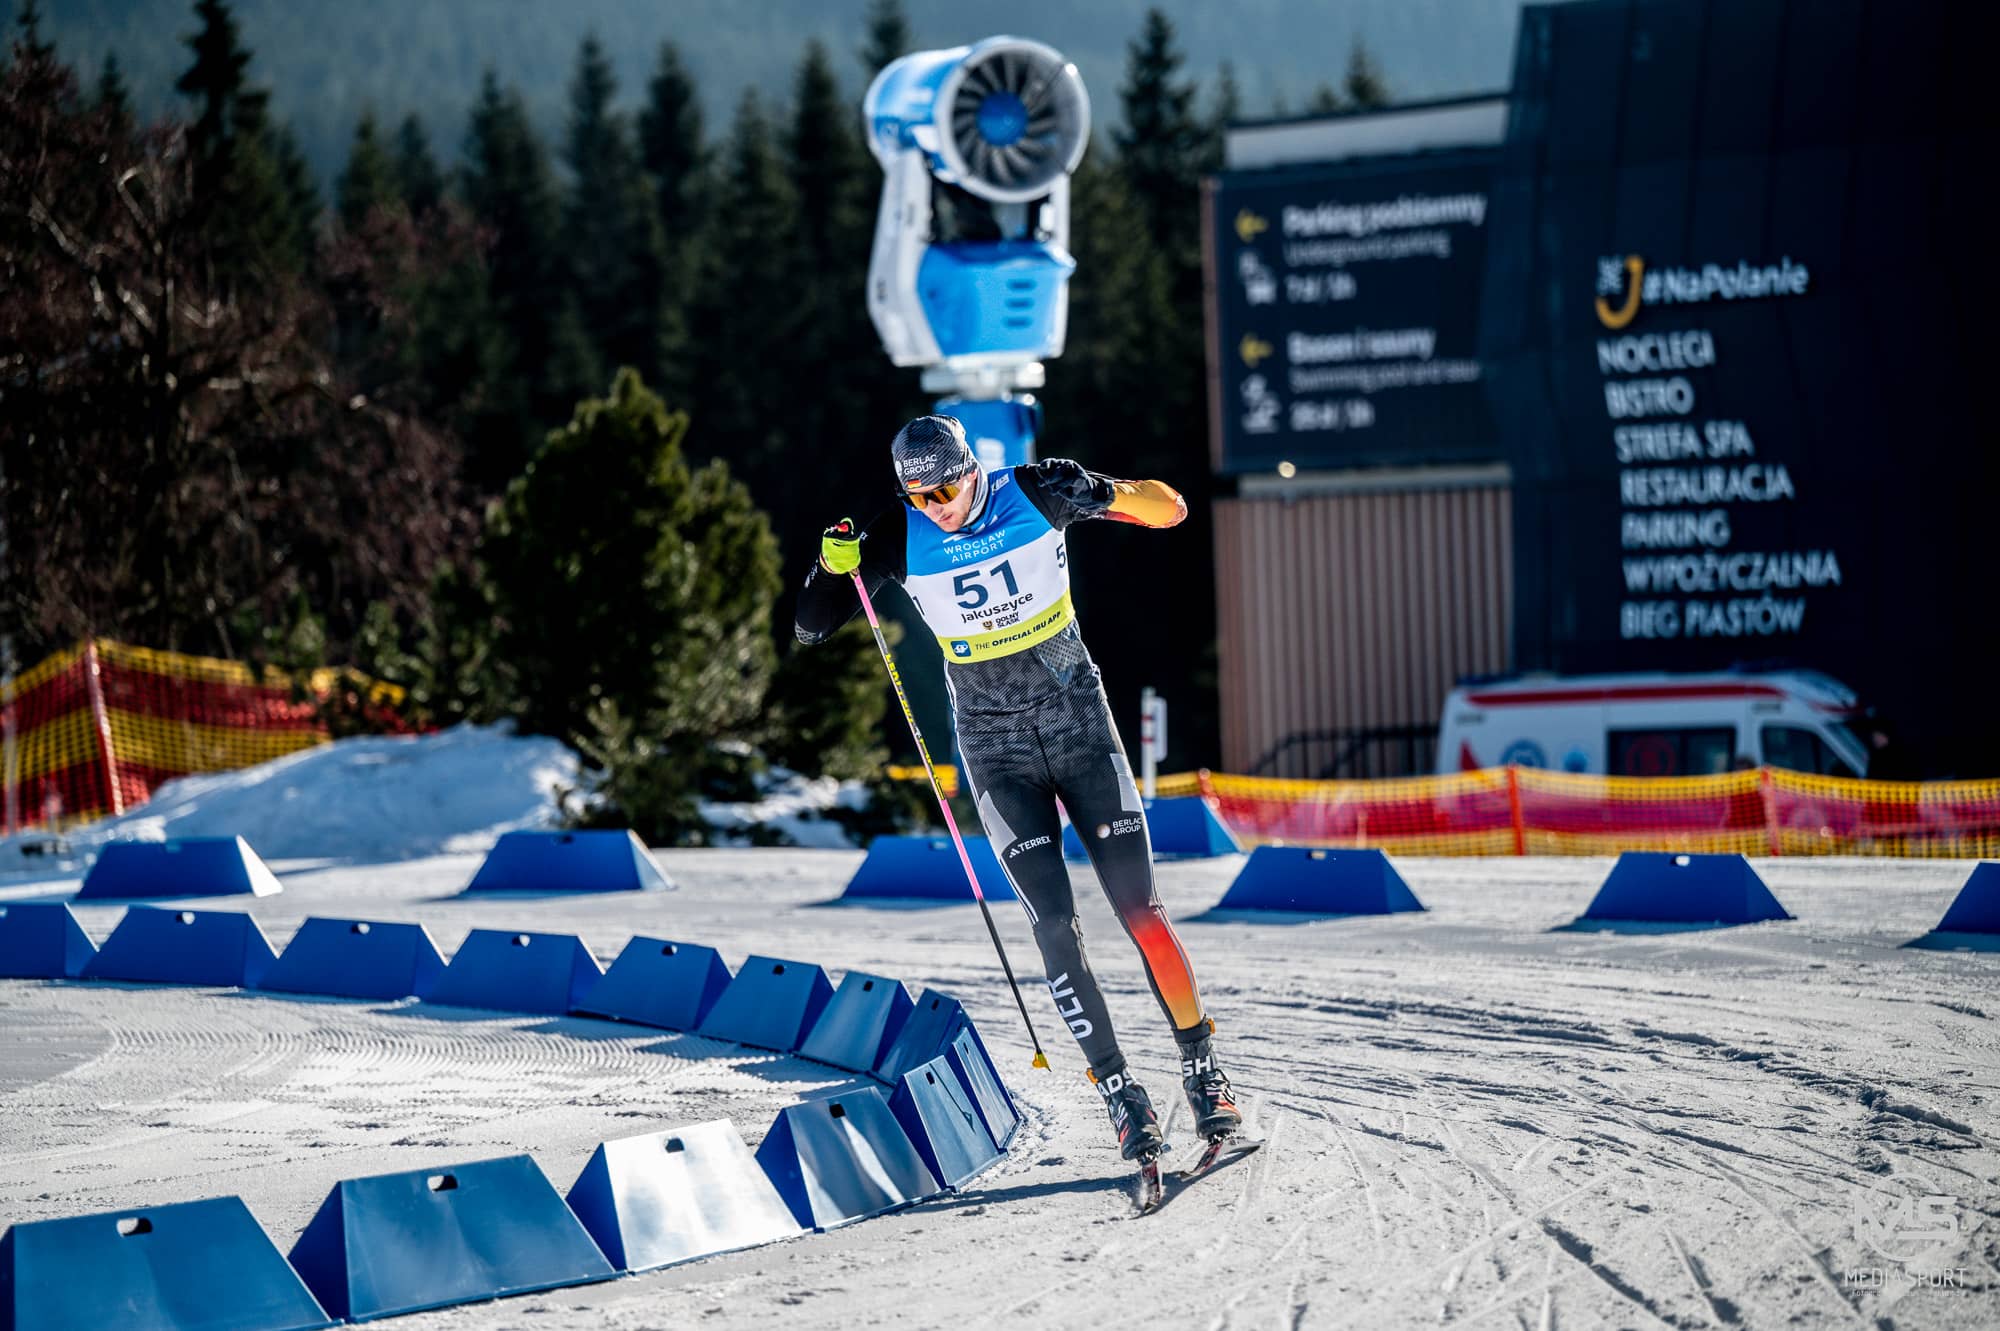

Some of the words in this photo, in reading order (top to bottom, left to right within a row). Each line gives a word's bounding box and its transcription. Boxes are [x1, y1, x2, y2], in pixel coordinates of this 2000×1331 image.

[1642, 255, 1809, 305] #NaPolanie
[1597, 330, 1715, 374] NOCLEGI
[1604, 376, 1694, 419] BISTRO
[903, 454, 938, 468] BERLAC
[1614, 422, 1703, 463] STREFA
[1705, 421, 1755, 458] SPA
[904, 463, 936, 476] GROUP
[1620, 464, 1795, 506] RESTAURACJA
[1621, 509, 1731, 549] PARKING
[952, 539, 1004, 563] AIRPORT
[1623, 550, 1841, 592] WYPOŻYCZALNIA
[953, 560, 1020, 609] 51
[961, 592, 1034, 623] Jakuszyce
[1620, 600, 1680, 639] BIEG
[1685, 588, 1805, 636] PIASTÓW
[976, 642, 990, 650] THE
[992, 629, 1032, 647] OFFICIAL
[1033, 620, 1047, 632] IBU
[1047, 611, 1061, 624] APP
[1113, 817, 1142, 829] BERLAC
[1114, 824, 1141, 836] GROUP
[1018, 836, 1051, 852] TERREX
